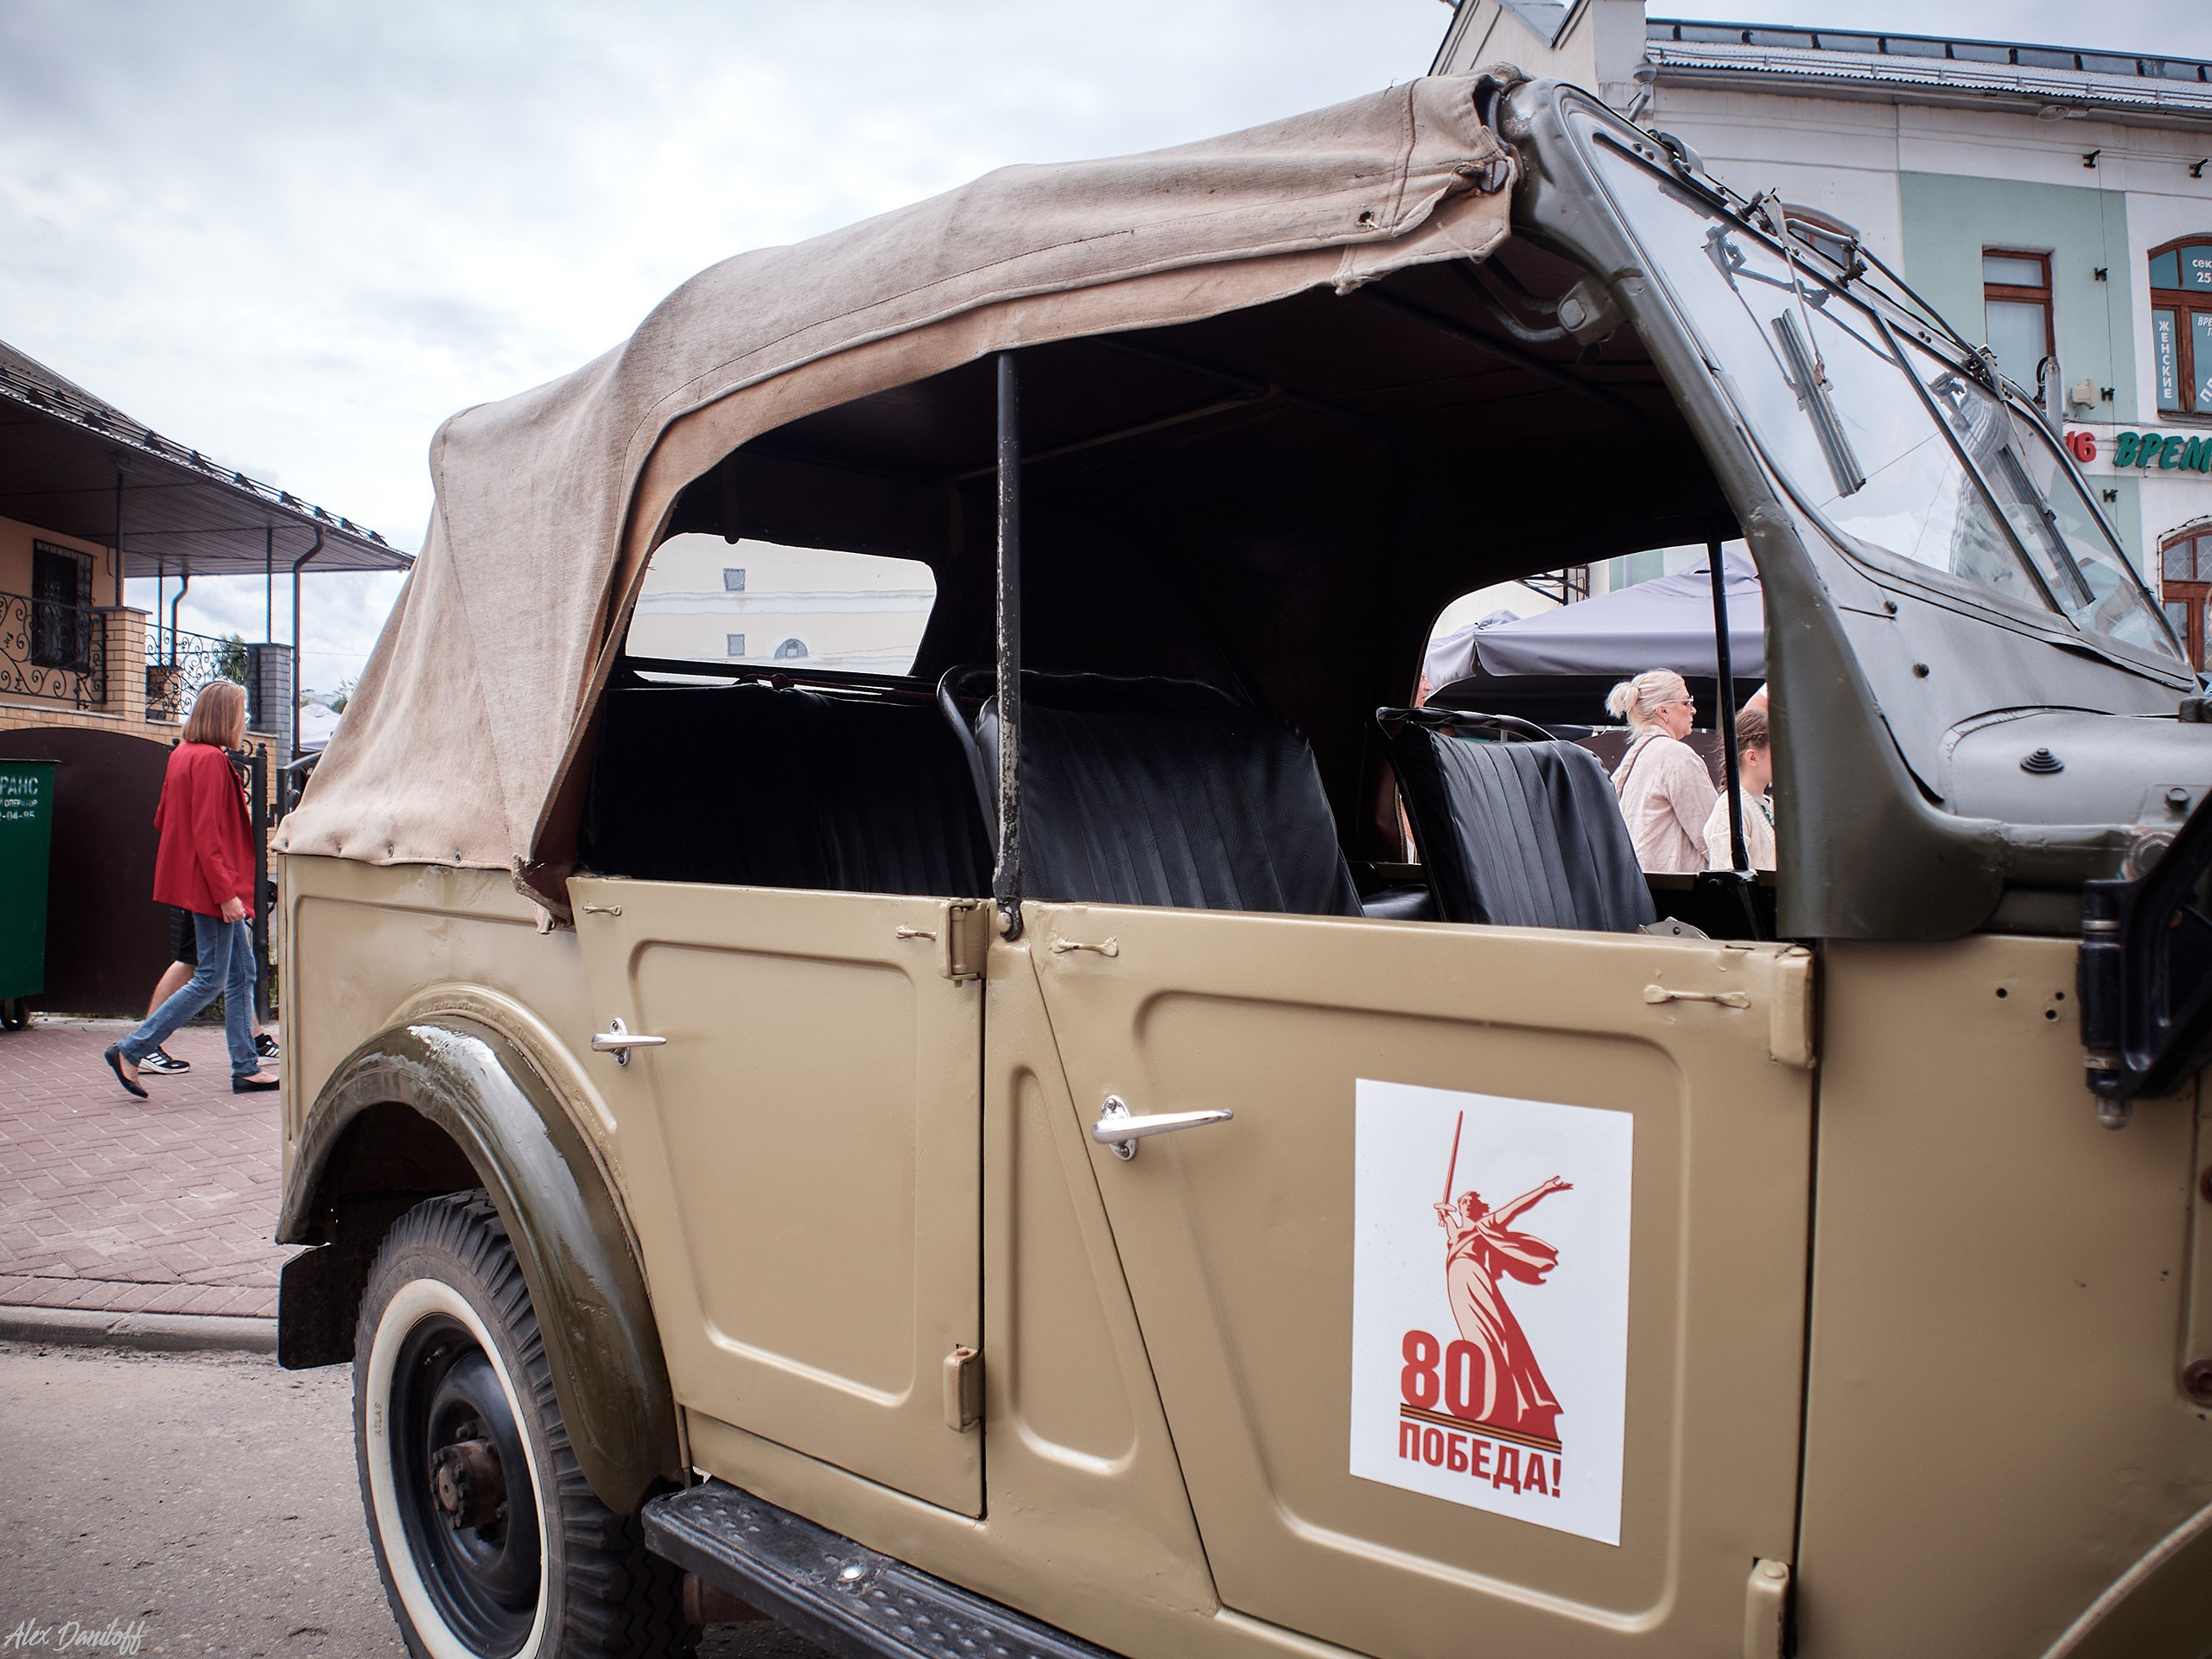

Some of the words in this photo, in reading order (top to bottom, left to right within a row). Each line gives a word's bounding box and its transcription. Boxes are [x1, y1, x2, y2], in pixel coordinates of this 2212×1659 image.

[2158, 321, 2172, 399] ЖЕНСКИЕ
[2113, 431, 2212, 474] ВРЕМ
[0, 776, 39, 795] РАНС
[1401, 1330, 1486, 1420] 80
[1398, 1421, 1561, 1498] ПОБЕДА!
